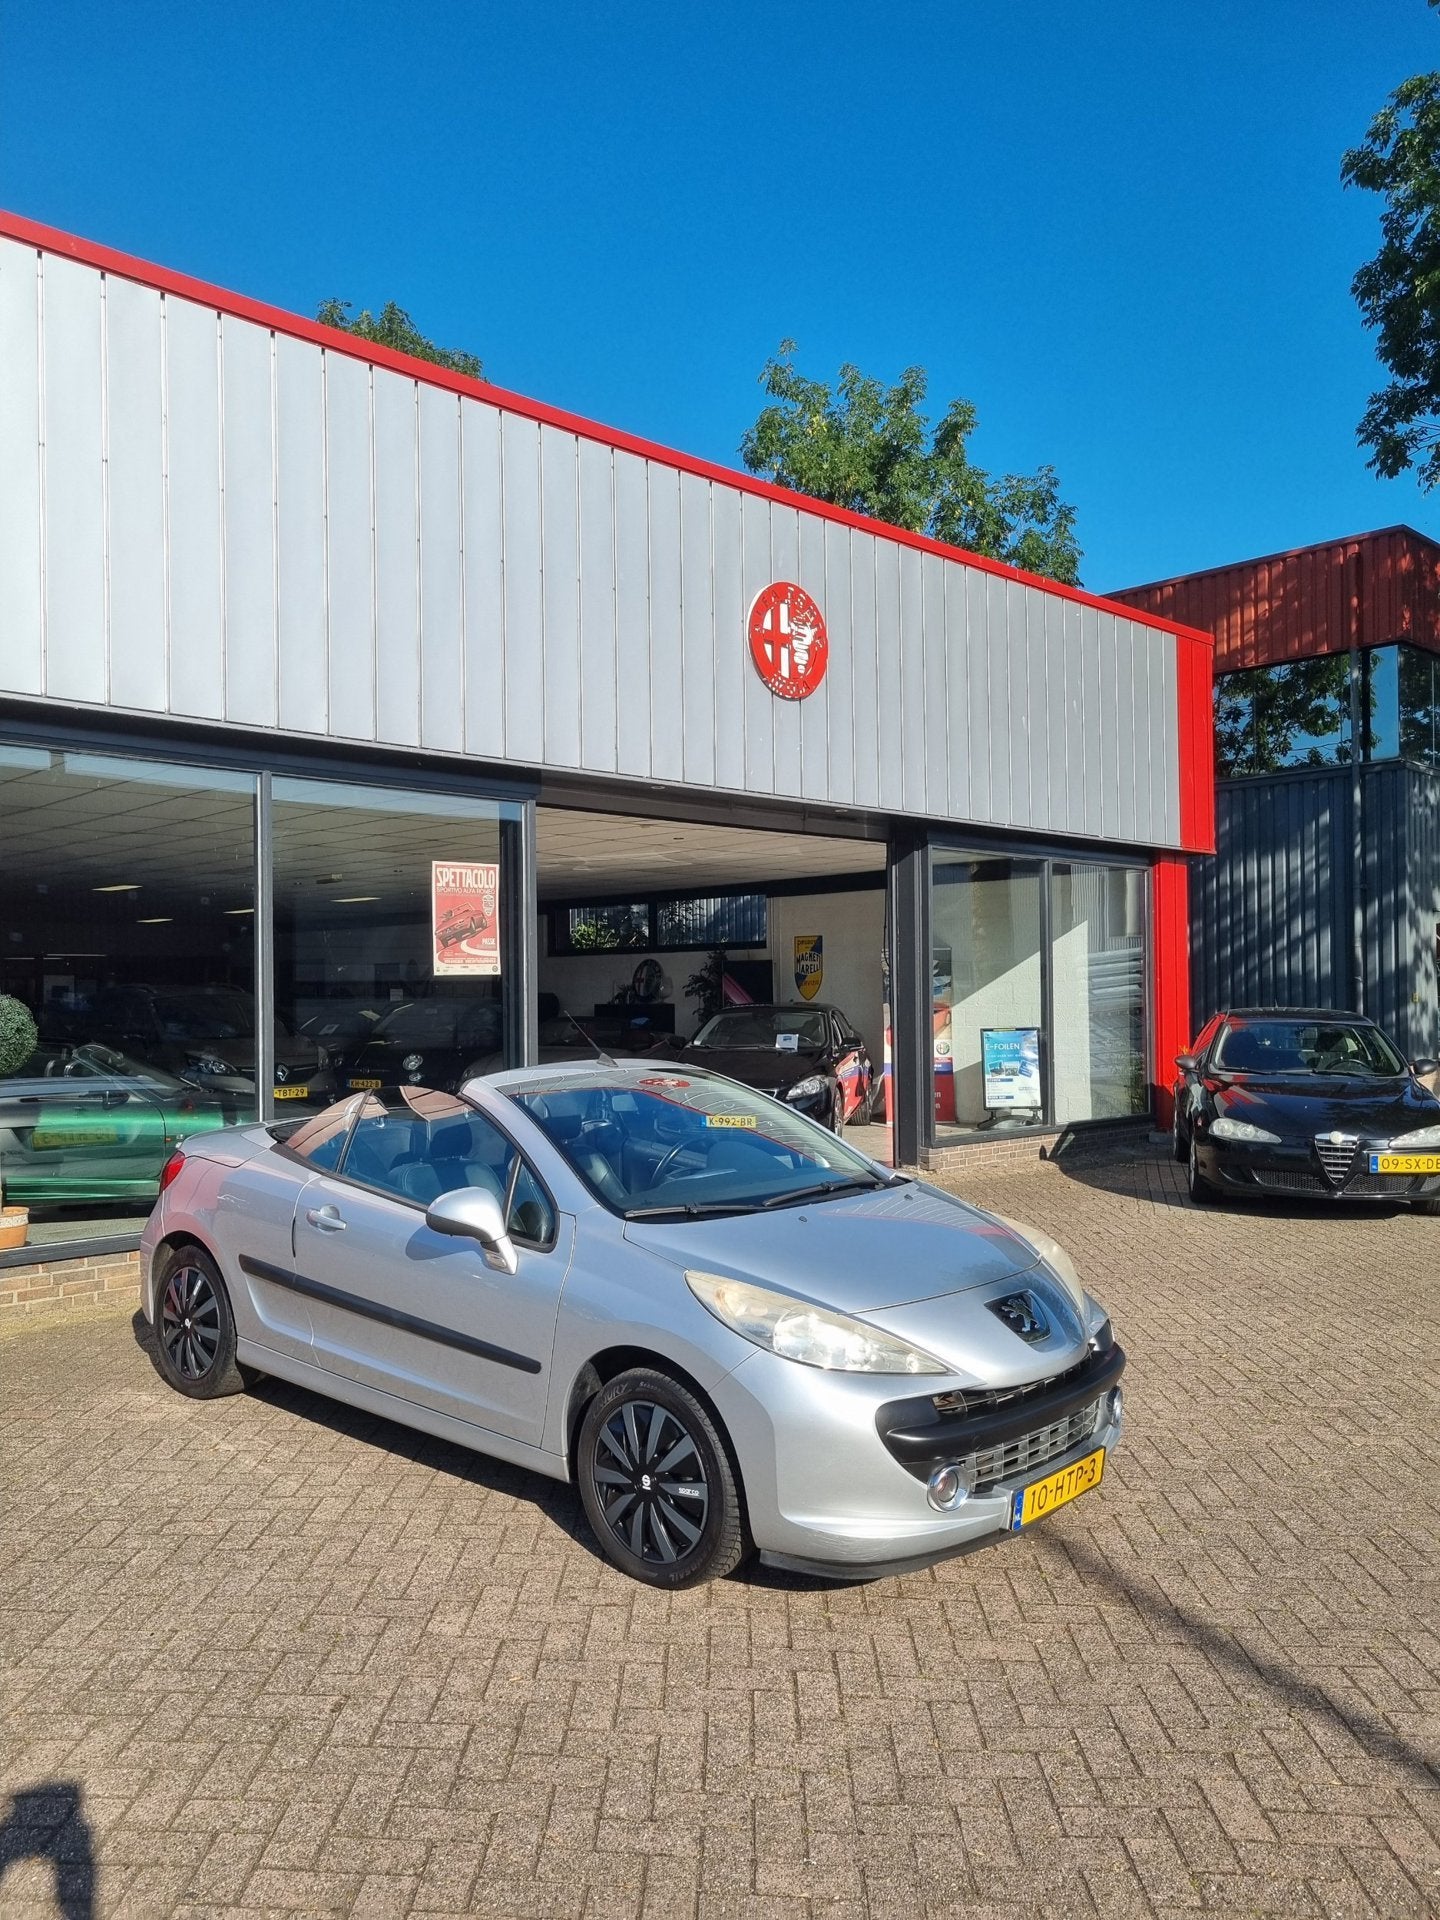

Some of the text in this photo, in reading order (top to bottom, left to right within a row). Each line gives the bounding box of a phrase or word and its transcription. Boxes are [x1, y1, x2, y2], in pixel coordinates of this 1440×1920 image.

[436, 867, 496, 889] SPETTACOLO
[985, 1042, 1021, 1051] E-FOILEN
[274, 1088, 305, 1098] -TBT-29
[708, 1117, 753, 1127] K-992-BR
[1030, 1457, 1096, 1515] 10-HTP-3
